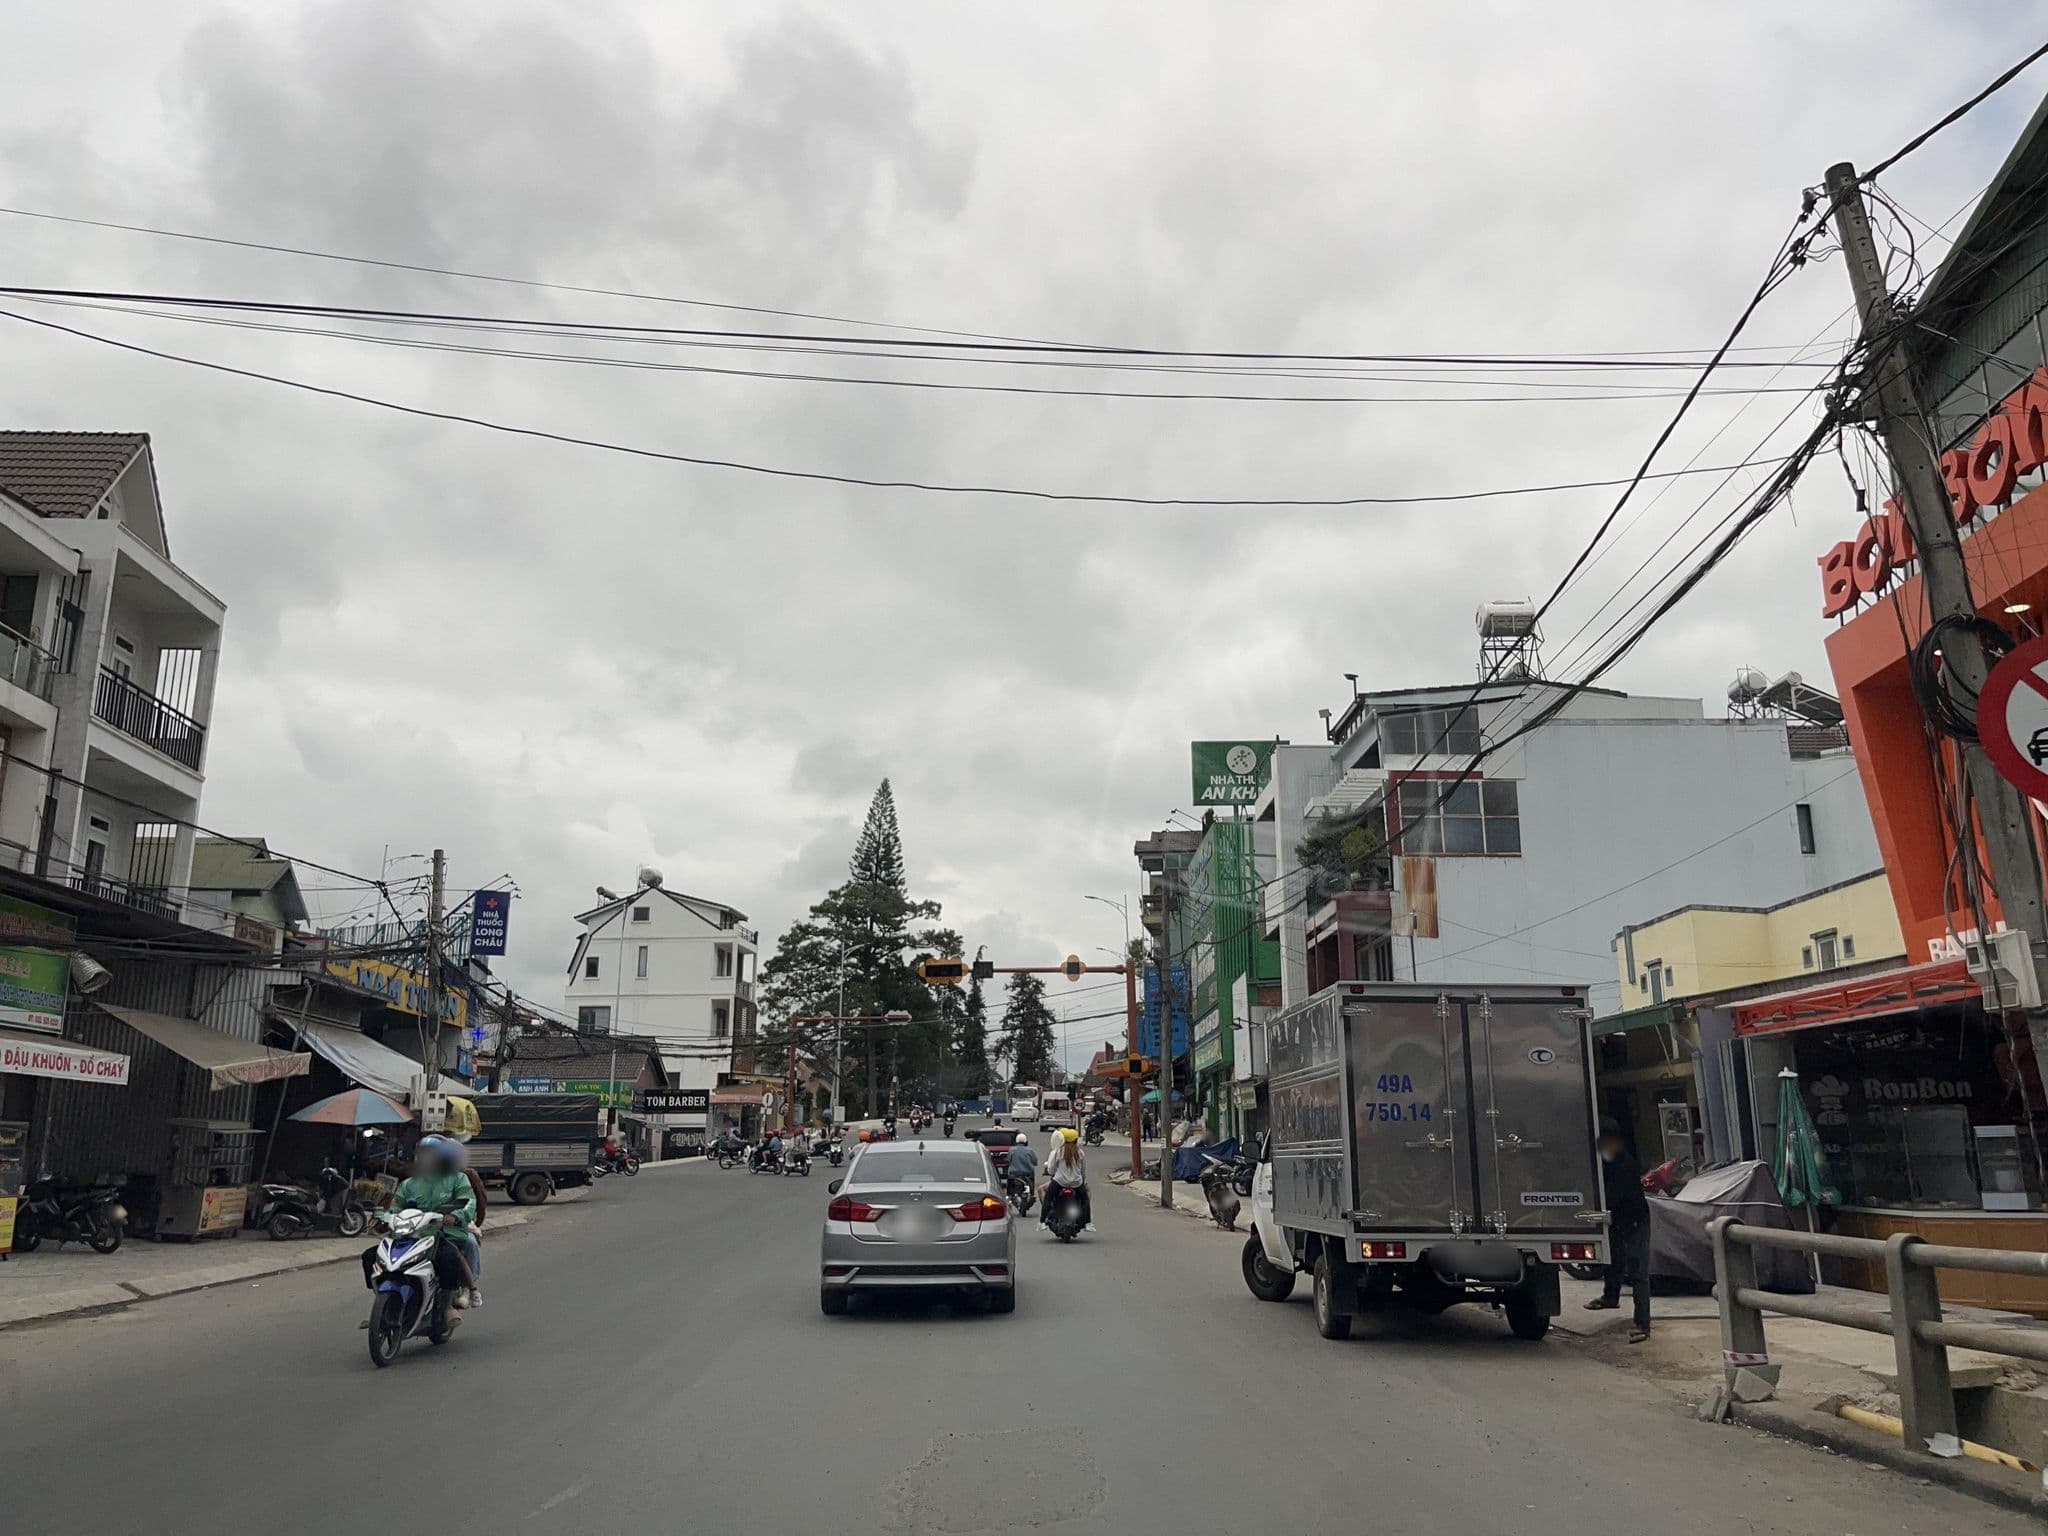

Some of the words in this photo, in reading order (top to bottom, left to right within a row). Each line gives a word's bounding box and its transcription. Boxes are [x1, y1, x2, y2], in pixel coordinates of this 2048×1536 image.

[1201, 786, 1226, 800] AN
[482, 910, 500, 918] NHÀ
[475, 928, 504, 937] LONG
[474, 937, 503, 947] CHÂU
[4, 1046, 29, 1071] ĐẬU
[32, 1052, 71, 1072] KHUÔN
[1377, 1074, 1413, 1094] 49A
[1863, 1077, 1973, 1099] BonBon
[646, 1096, 666, 1106] TOM
[668, 1096, 706, 1107] BARBER
[1366, 1103, 1432, 1122] 750.14
[1523, 1194, 1581, 1204] FRONTIER
